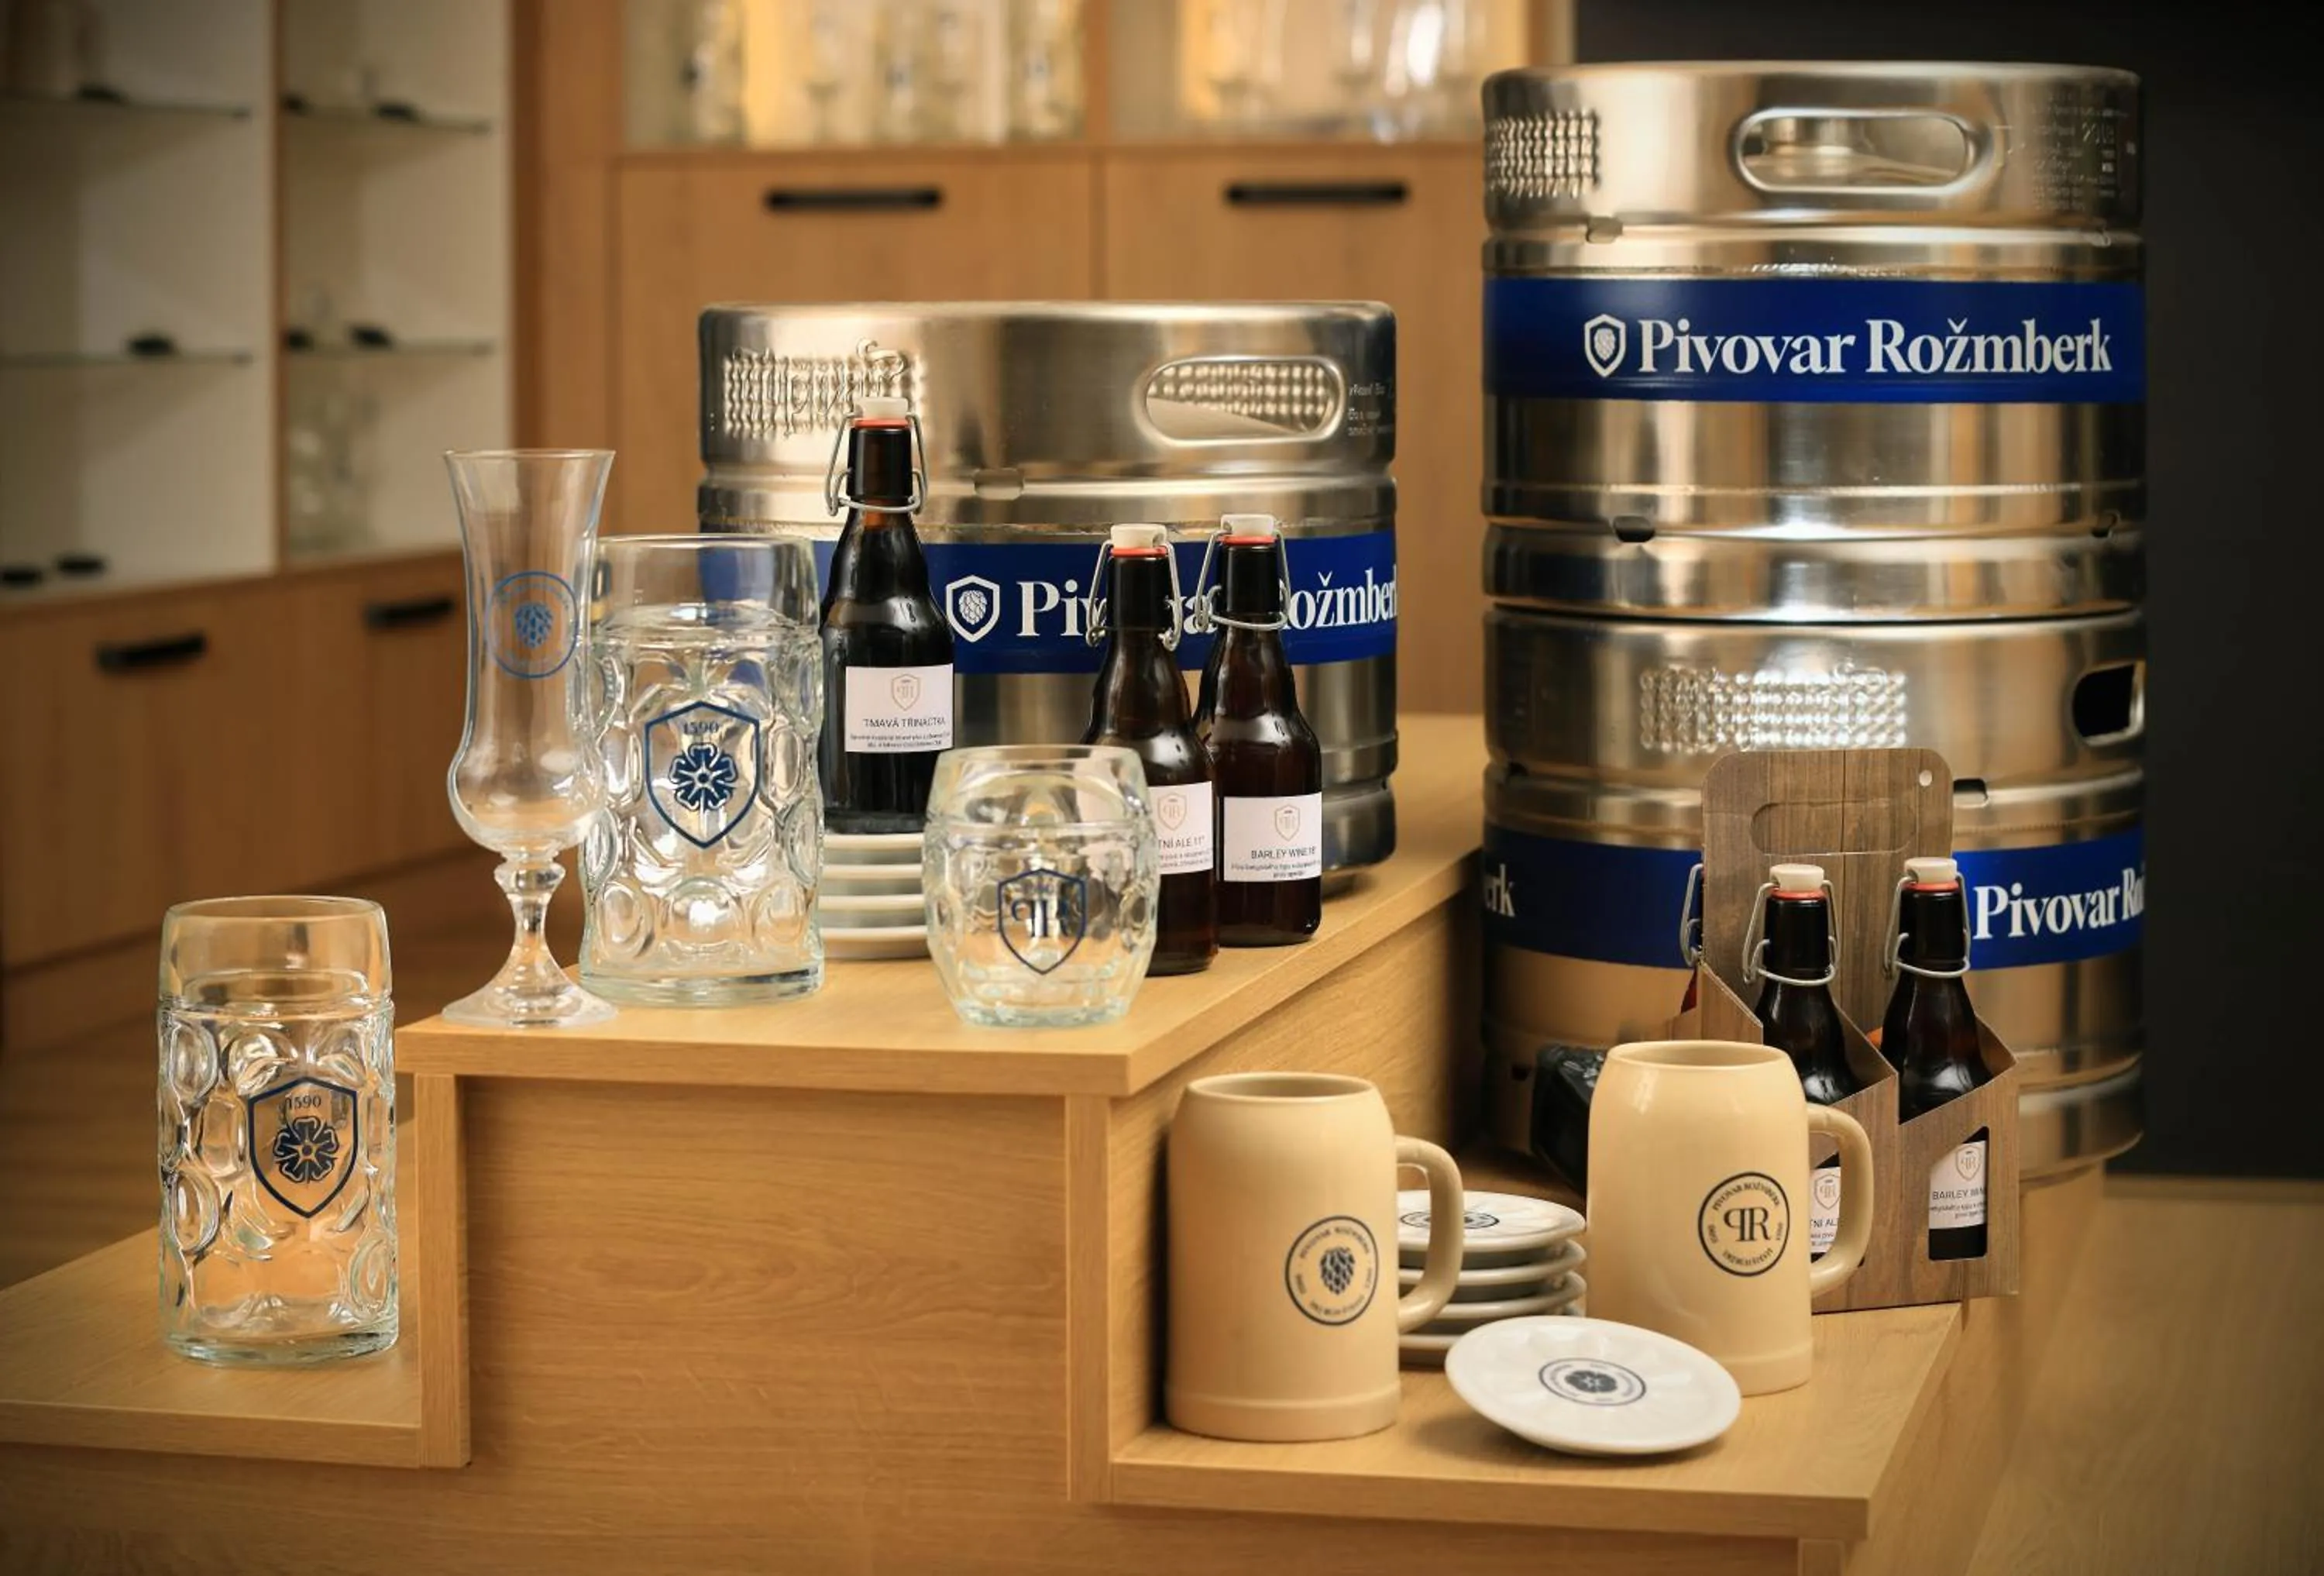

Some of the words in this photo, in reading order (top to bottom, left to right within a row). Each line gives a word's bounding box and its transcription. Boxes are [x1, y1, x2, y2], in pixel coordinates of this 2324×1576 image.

[1638, 318, 1856, 374] Pivovar
[1865, 318, 2113, 373] Rožmberk
[1280, 564, 1397, 630] ožmber
[683, 721, 720, 736] 1590
[1251, 848, 1287, 859] BARLEY
[1972, 883, 2120, 940] Pivovar
[284, 1094, 322, 1110] 1590
[1932, 1190, 1968, 1200] BARLEY
